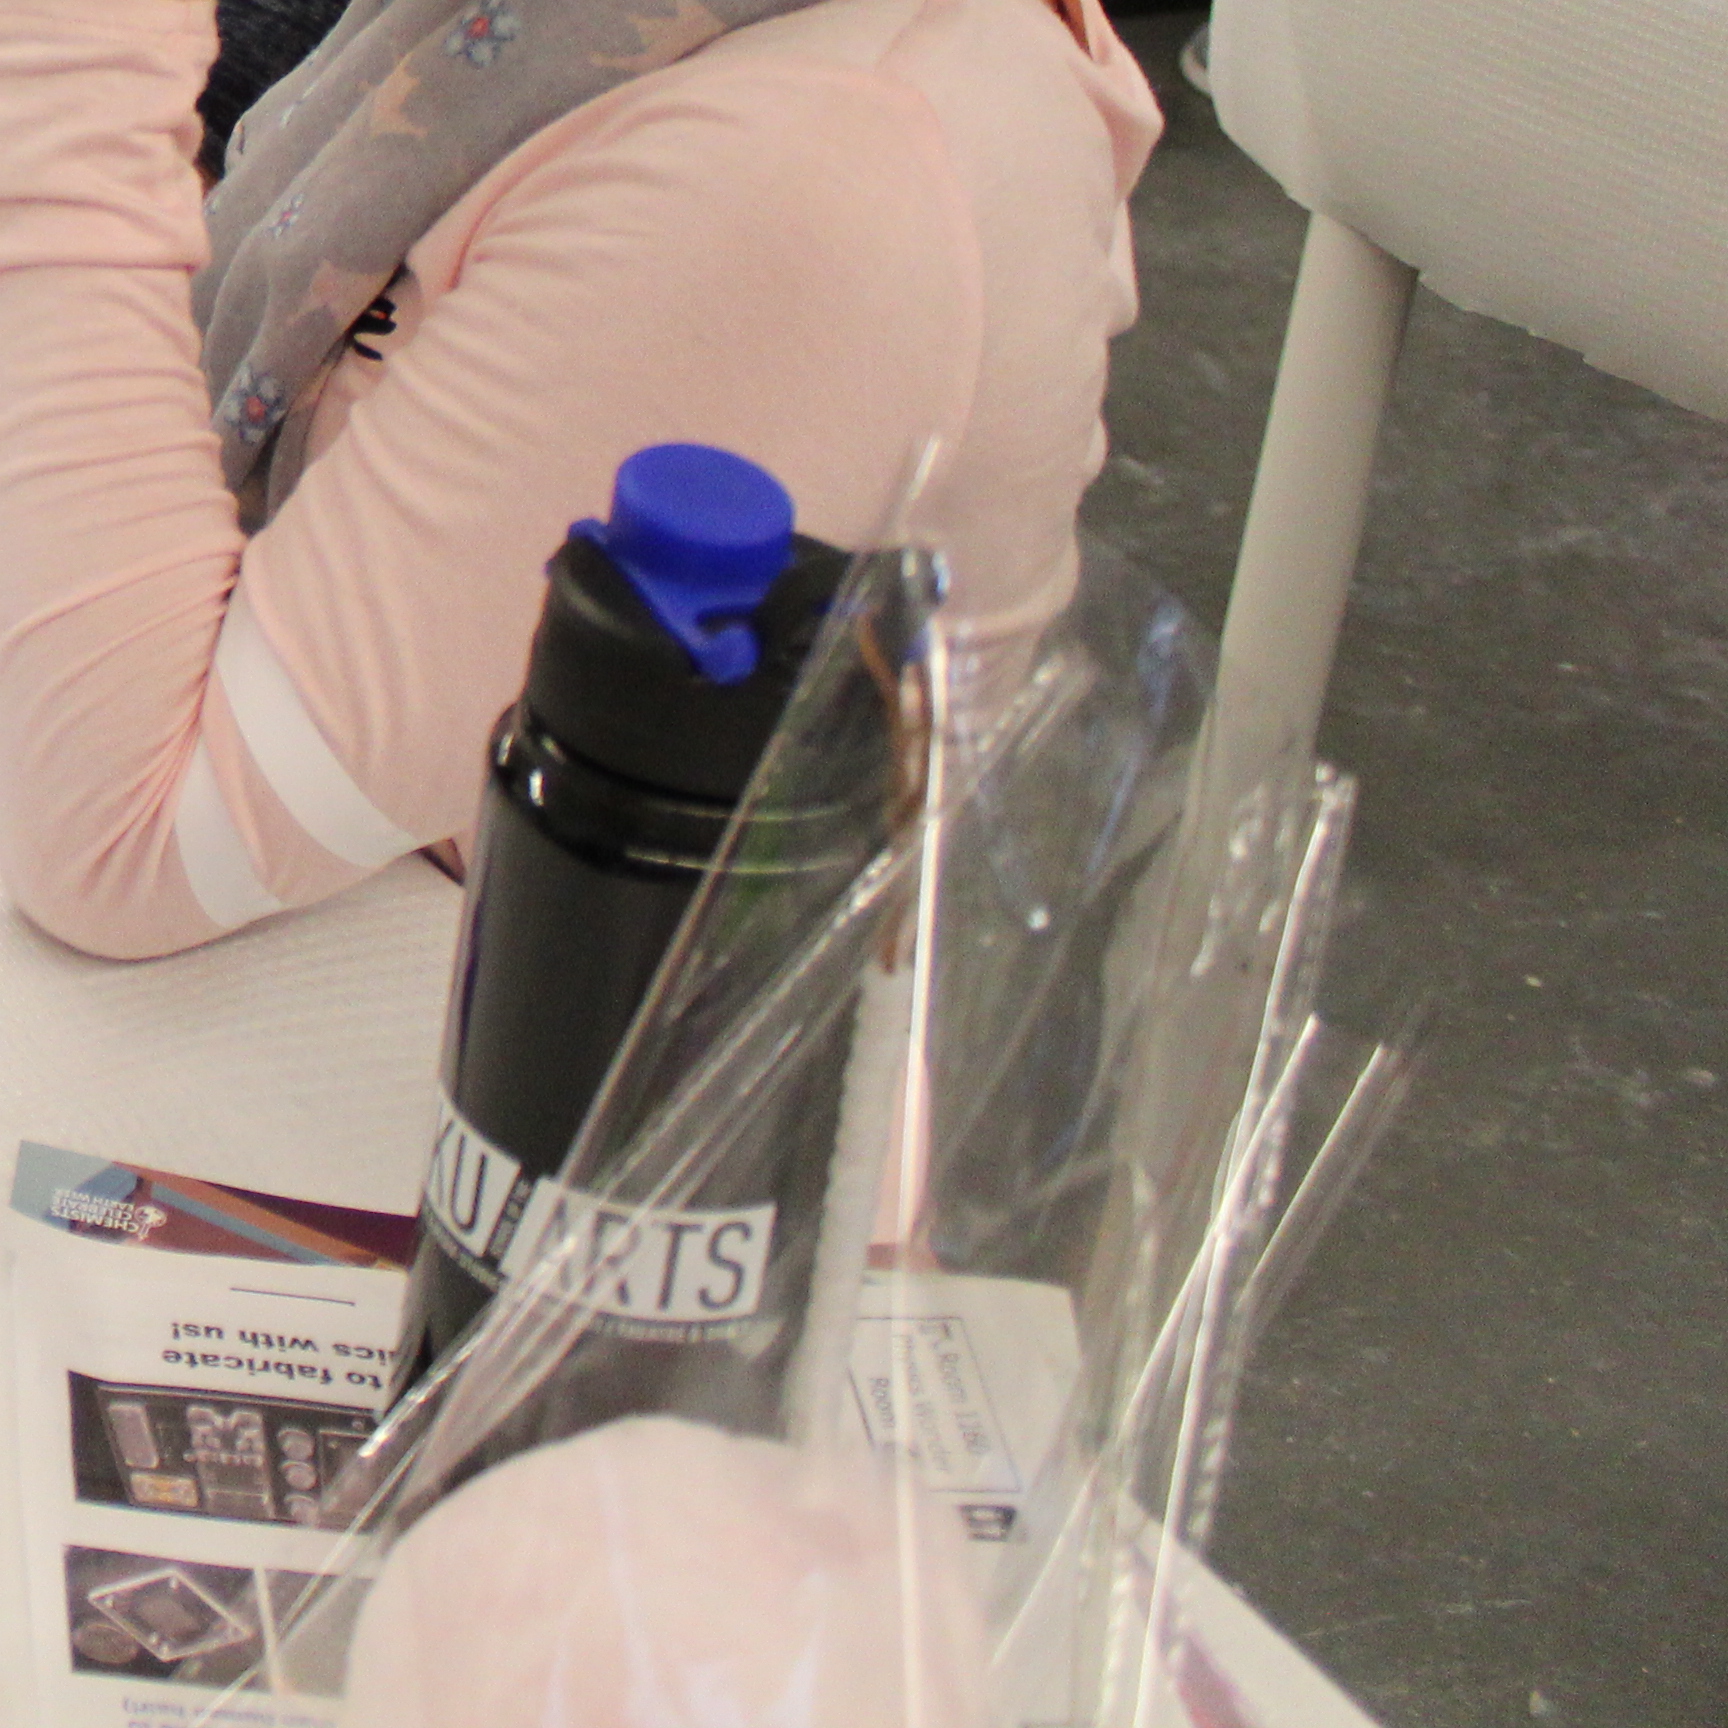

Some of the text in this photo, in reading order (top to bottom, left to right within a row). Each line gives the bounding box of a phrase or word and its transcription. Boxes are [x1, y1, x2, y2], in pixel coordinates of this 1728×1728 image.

[50, 1206, 139, 1233] CHEMISTS
[52, 1196, 133, 1221] CELEBRATE
[171, 1322, 319, 1353] with us!
[162, 1349, 382, 1391] to fabricate
